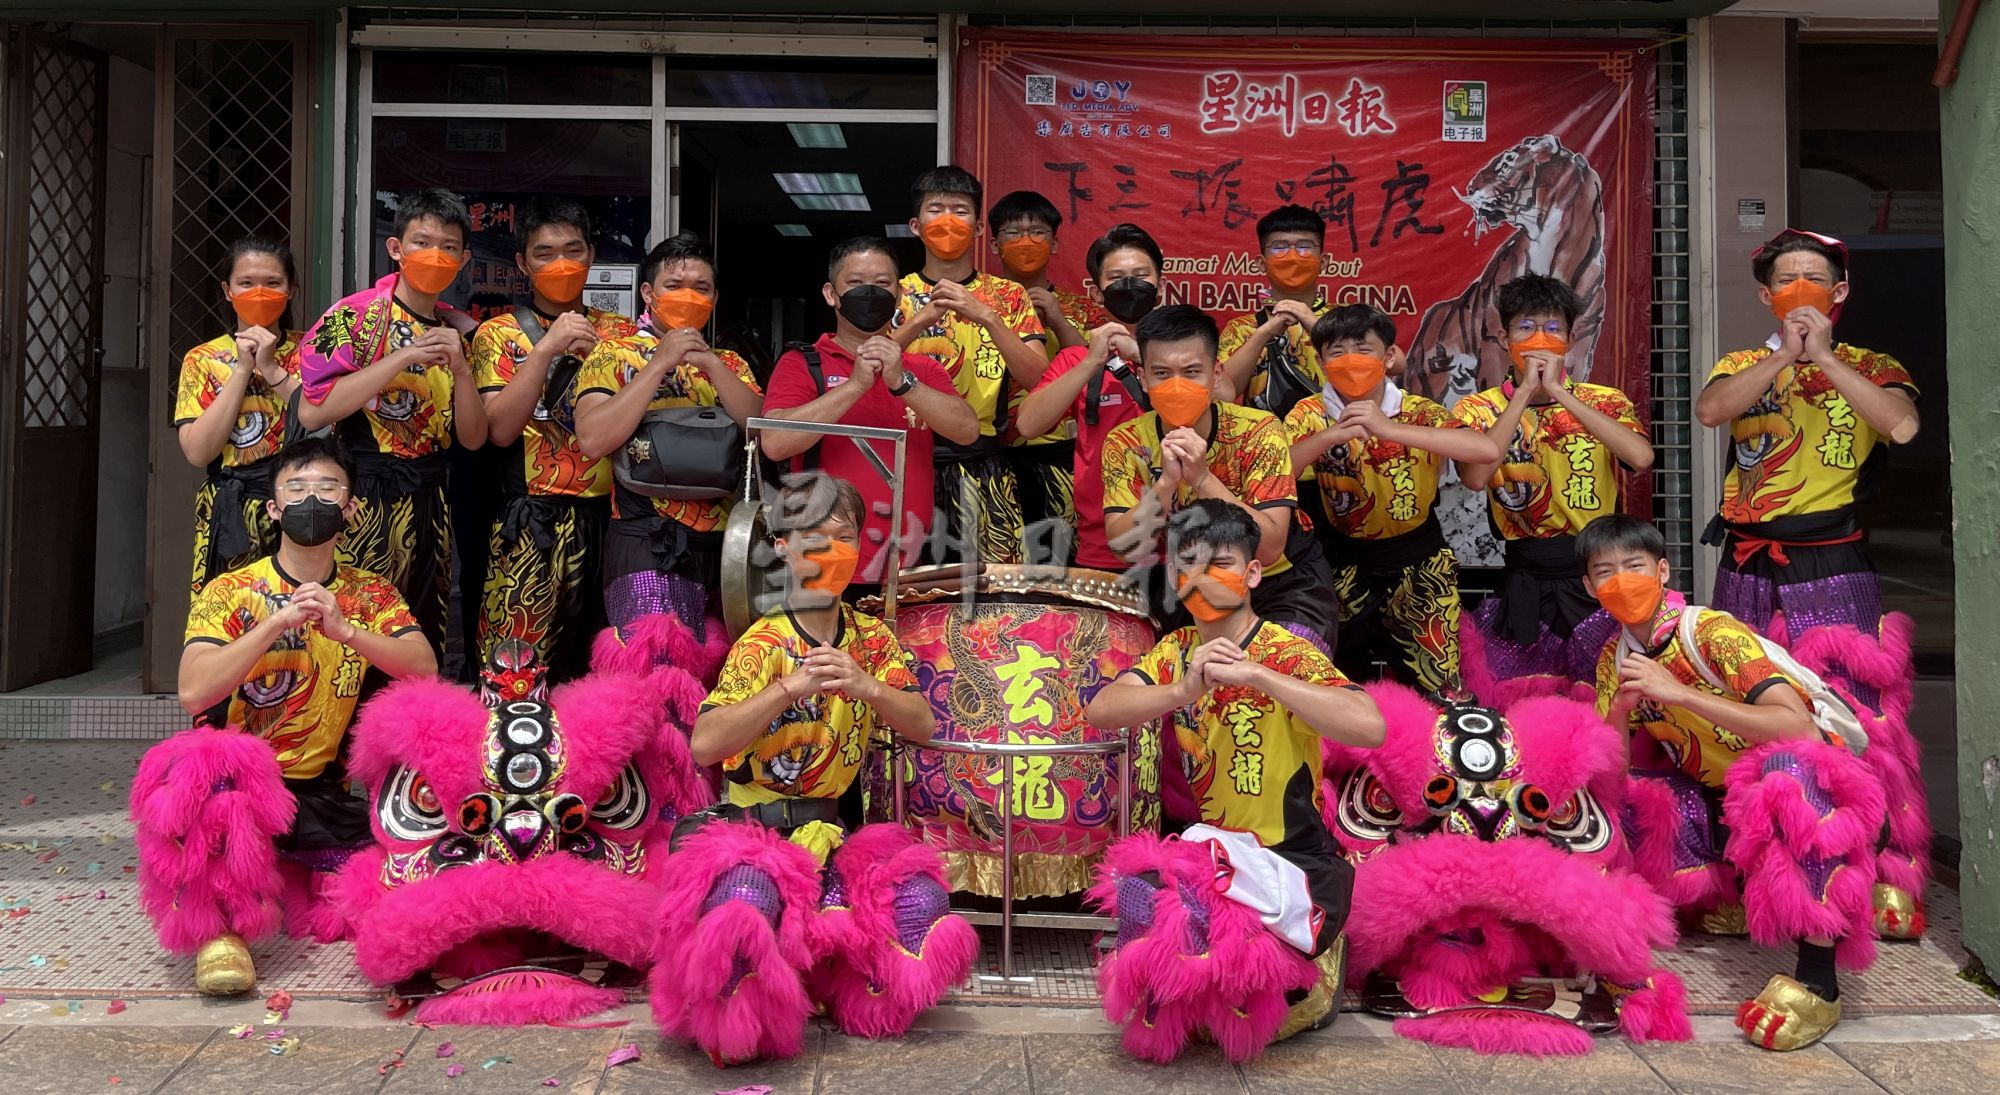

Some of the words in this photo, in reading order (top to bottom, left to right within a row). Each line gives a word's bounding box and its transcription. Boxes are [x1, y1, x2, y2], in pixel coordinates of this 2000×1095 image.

[1071, 81, 1131, 100] JOY
[1468, 89, 1483, 116] 星洲
[1083, 103, 1114, 111] MEDIA
[1444, 126, 1484, 140] 电子报
[1338, 285, 1417, 316] CINA
[1562, 436, 1601, 511] 玄龍
[1386, 458, 1420, 522] 玄龍
[986, 645, 1066, 820] 玄龍
[1227, 703, 1264, 796] 玄龍
